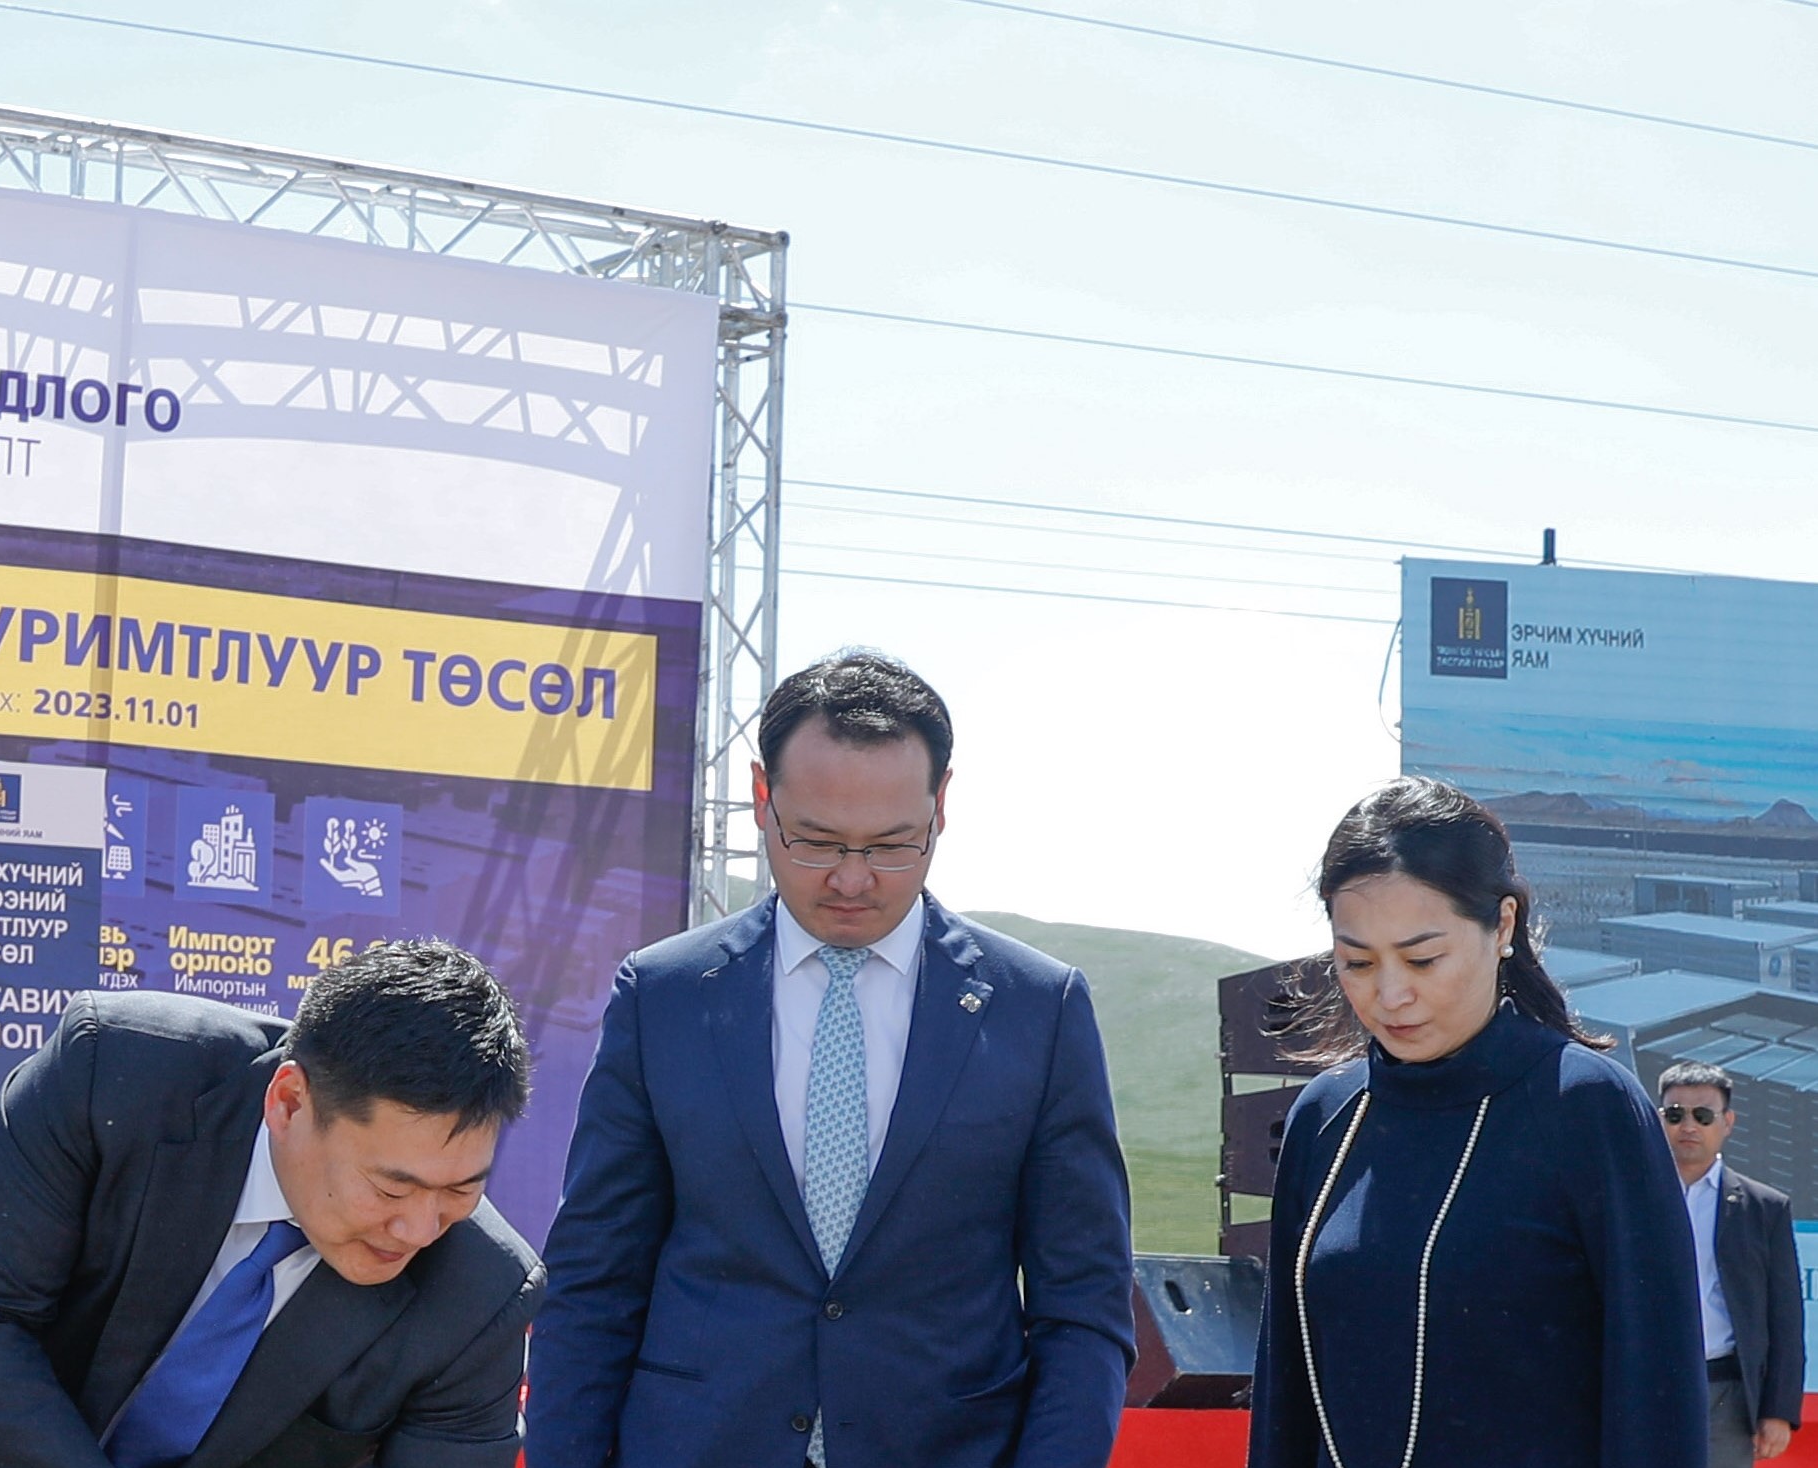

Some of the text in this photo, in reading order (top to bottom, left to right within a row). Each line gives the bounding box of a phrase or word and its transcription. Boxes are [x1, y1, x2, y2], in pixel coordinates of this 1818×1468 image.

[1511, 624, 1645, 649] ЭРЧИМ ХҮЧНИЙ
[1511, 649, 1549, 669] ЯАМ
[403, 650, 618, 720] ТӨСӨЛ
[32, 687, 200, 729] 2023.11.01
[169, 926, 276, 956] Импорт
[170, 951, 272, 975] орлоно
[175, 974, 266, 999] Импортын
